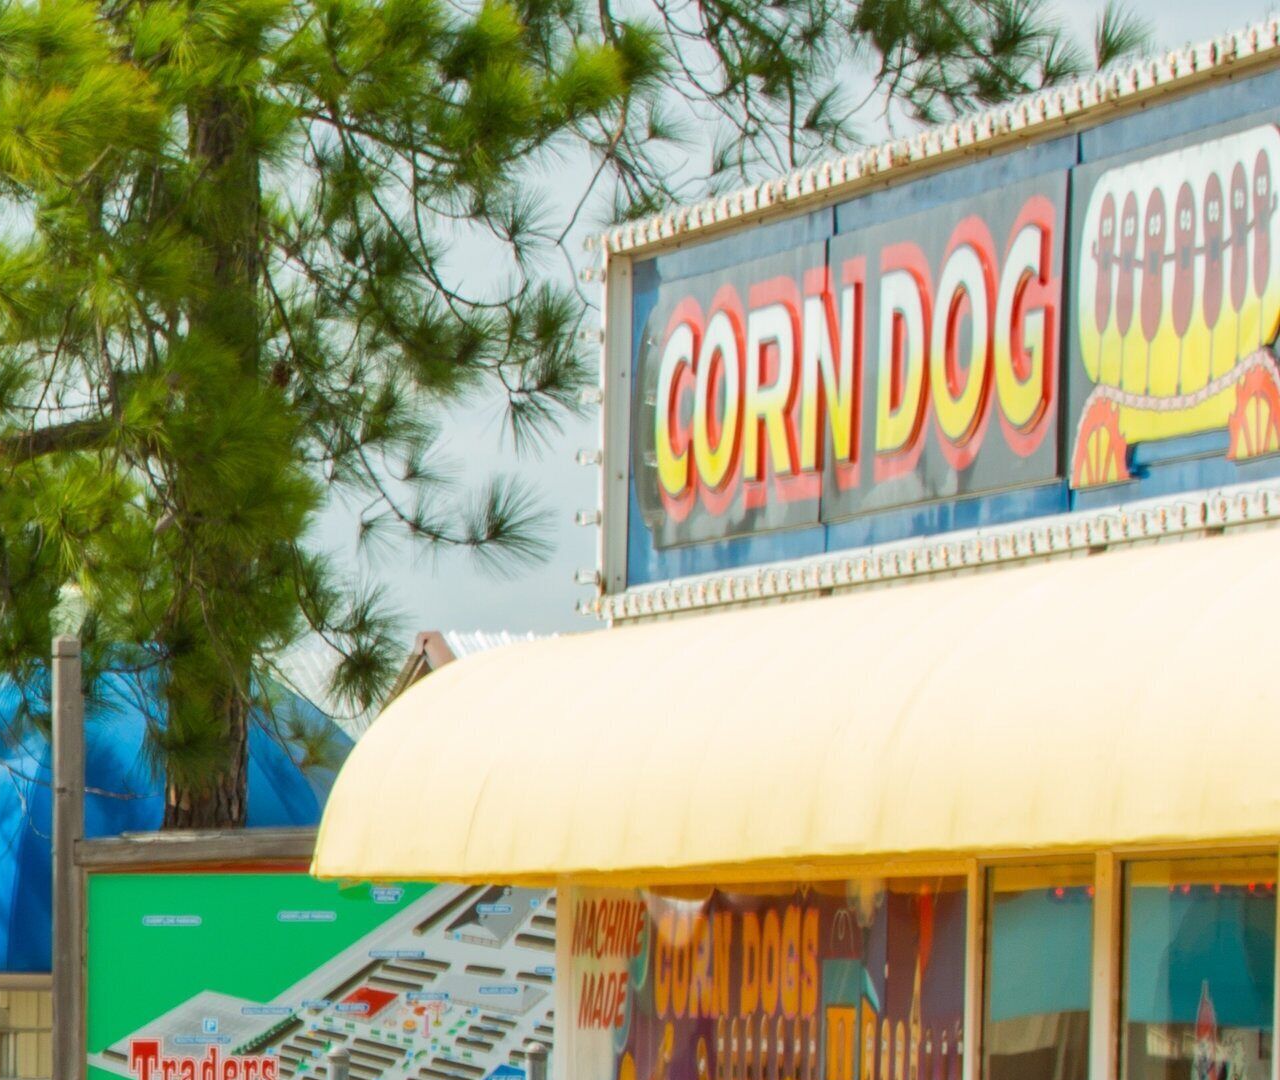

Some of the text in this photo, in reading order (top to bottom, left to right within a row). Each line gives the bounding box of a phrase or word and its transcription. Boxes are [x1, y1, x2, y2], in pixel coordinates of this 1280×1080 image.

[656, 212, 1056, 505] CORN DOG
[572, 898, 647, 960] MACHINE
[655, 904, 820, 1020] CORN DOGS
[578, 970, 628, 1029] MADE
